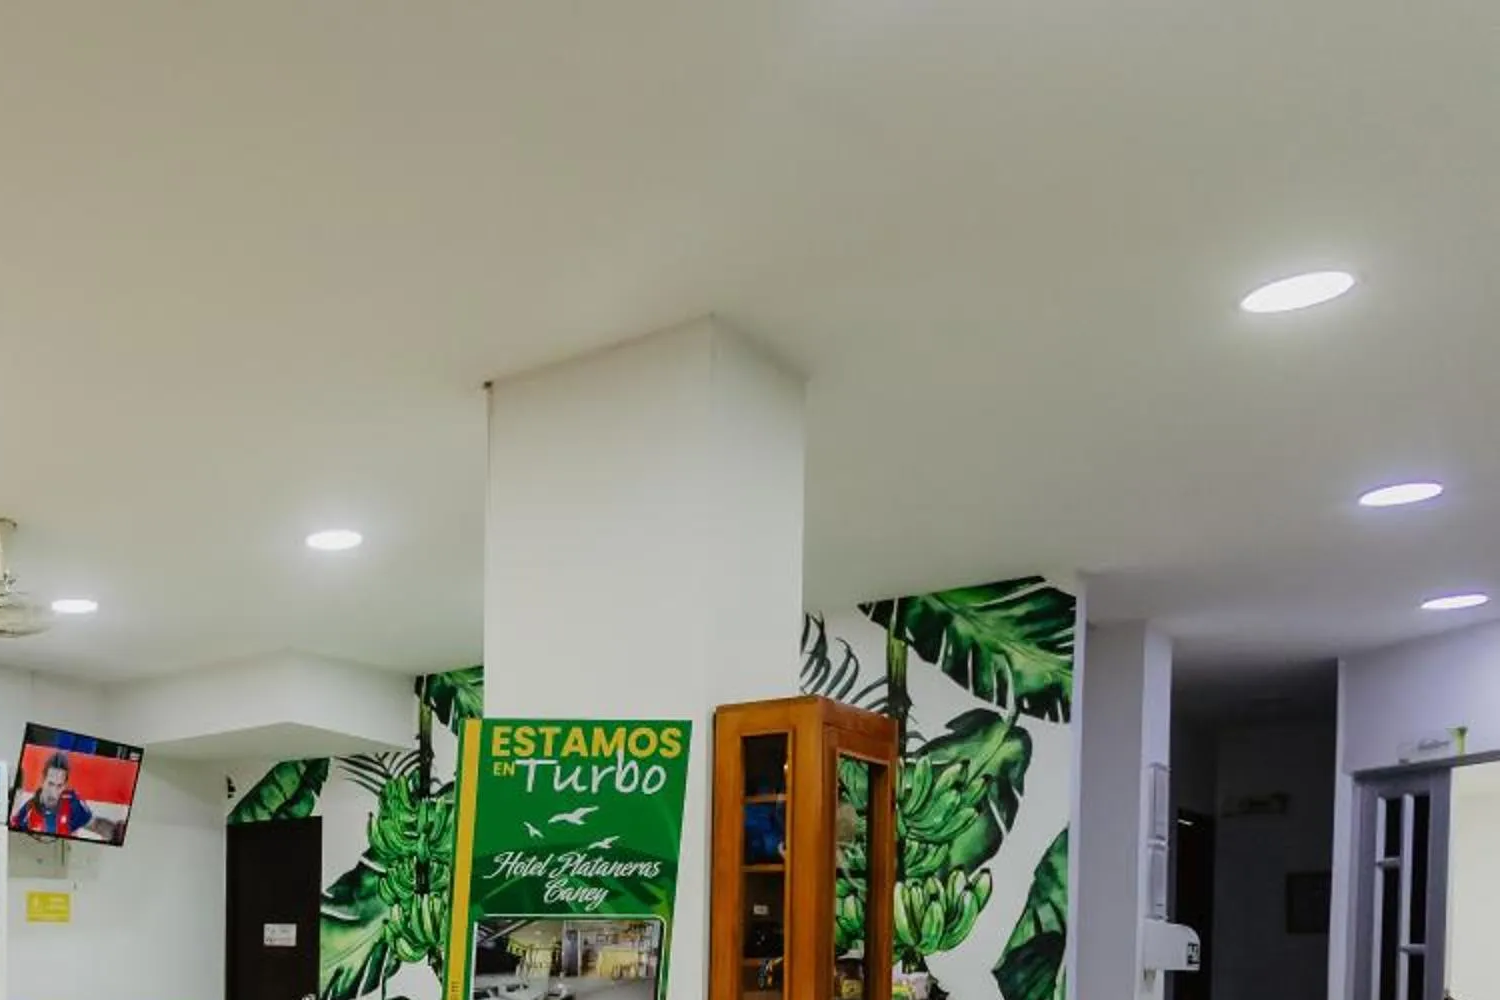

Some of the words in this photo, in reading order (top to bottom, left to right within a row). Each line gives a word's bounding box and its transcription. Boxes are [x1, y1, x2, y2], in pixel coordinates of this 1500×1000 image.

[491, 726, 682, 759] ESTAMOS
[493, 761, 515, 777] EN
[515, 750, 667, 795] Turbo
[483, 851, 555, 879] Hotel
[549, 851, 662, 879] Plataneras
[543, 875, 609, 912] Caney
